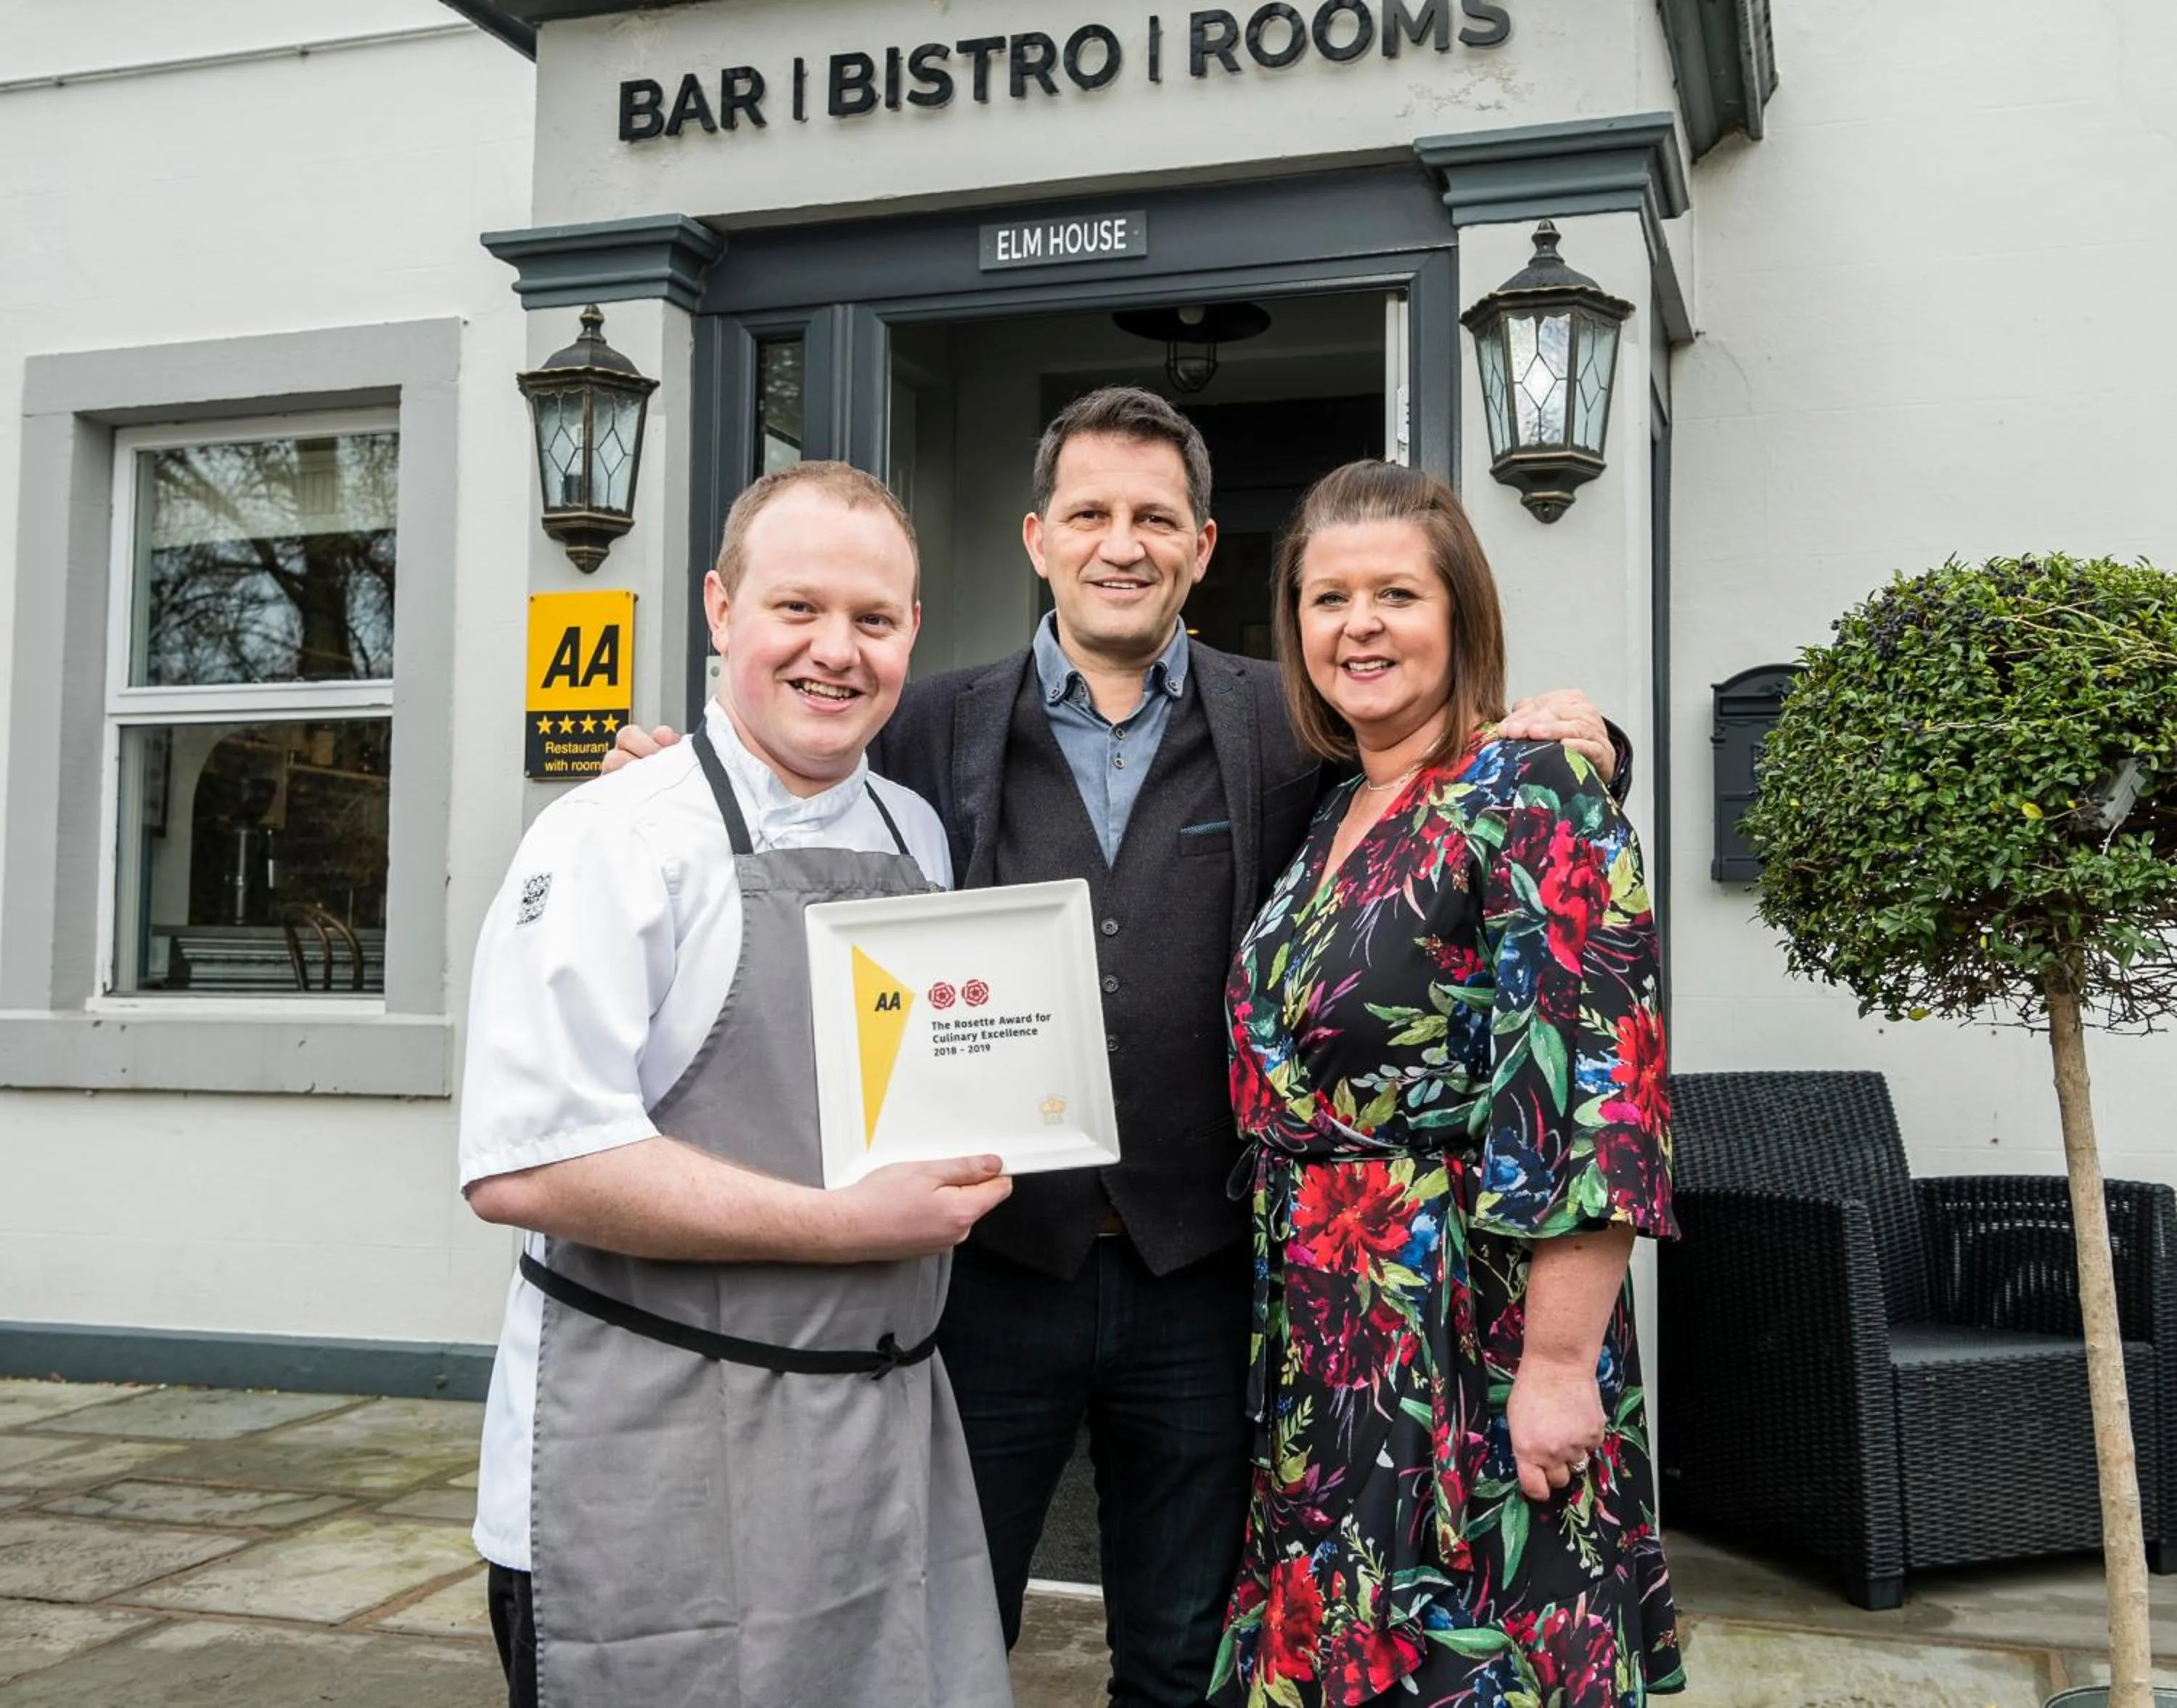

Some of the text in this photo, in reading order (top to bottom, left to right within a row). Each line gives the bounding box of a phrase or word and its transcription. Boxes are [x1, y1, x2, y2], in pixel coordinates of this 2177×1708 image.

[619, 66, 767, 141] BAR
[828, 24, 1122, 117] BISTRO
[1190, 0, 1511, 76] ROOMS
[997, 219, 1127, 260] ELM HOUSE
[541, 624, 620, 689] AA
[545, 741, 609, 754] Restaurant
[545, 759, 603, 772] with room
[874, 991, 901, 1012] AA
[932, 1013, 1051, 1030] The Rosette Award for
[932, 1027, 1038, 1043] Culinary Excellence
[934, 1046, 957, 1056] 2018
[968, 1043, 991, 1054] 2019
